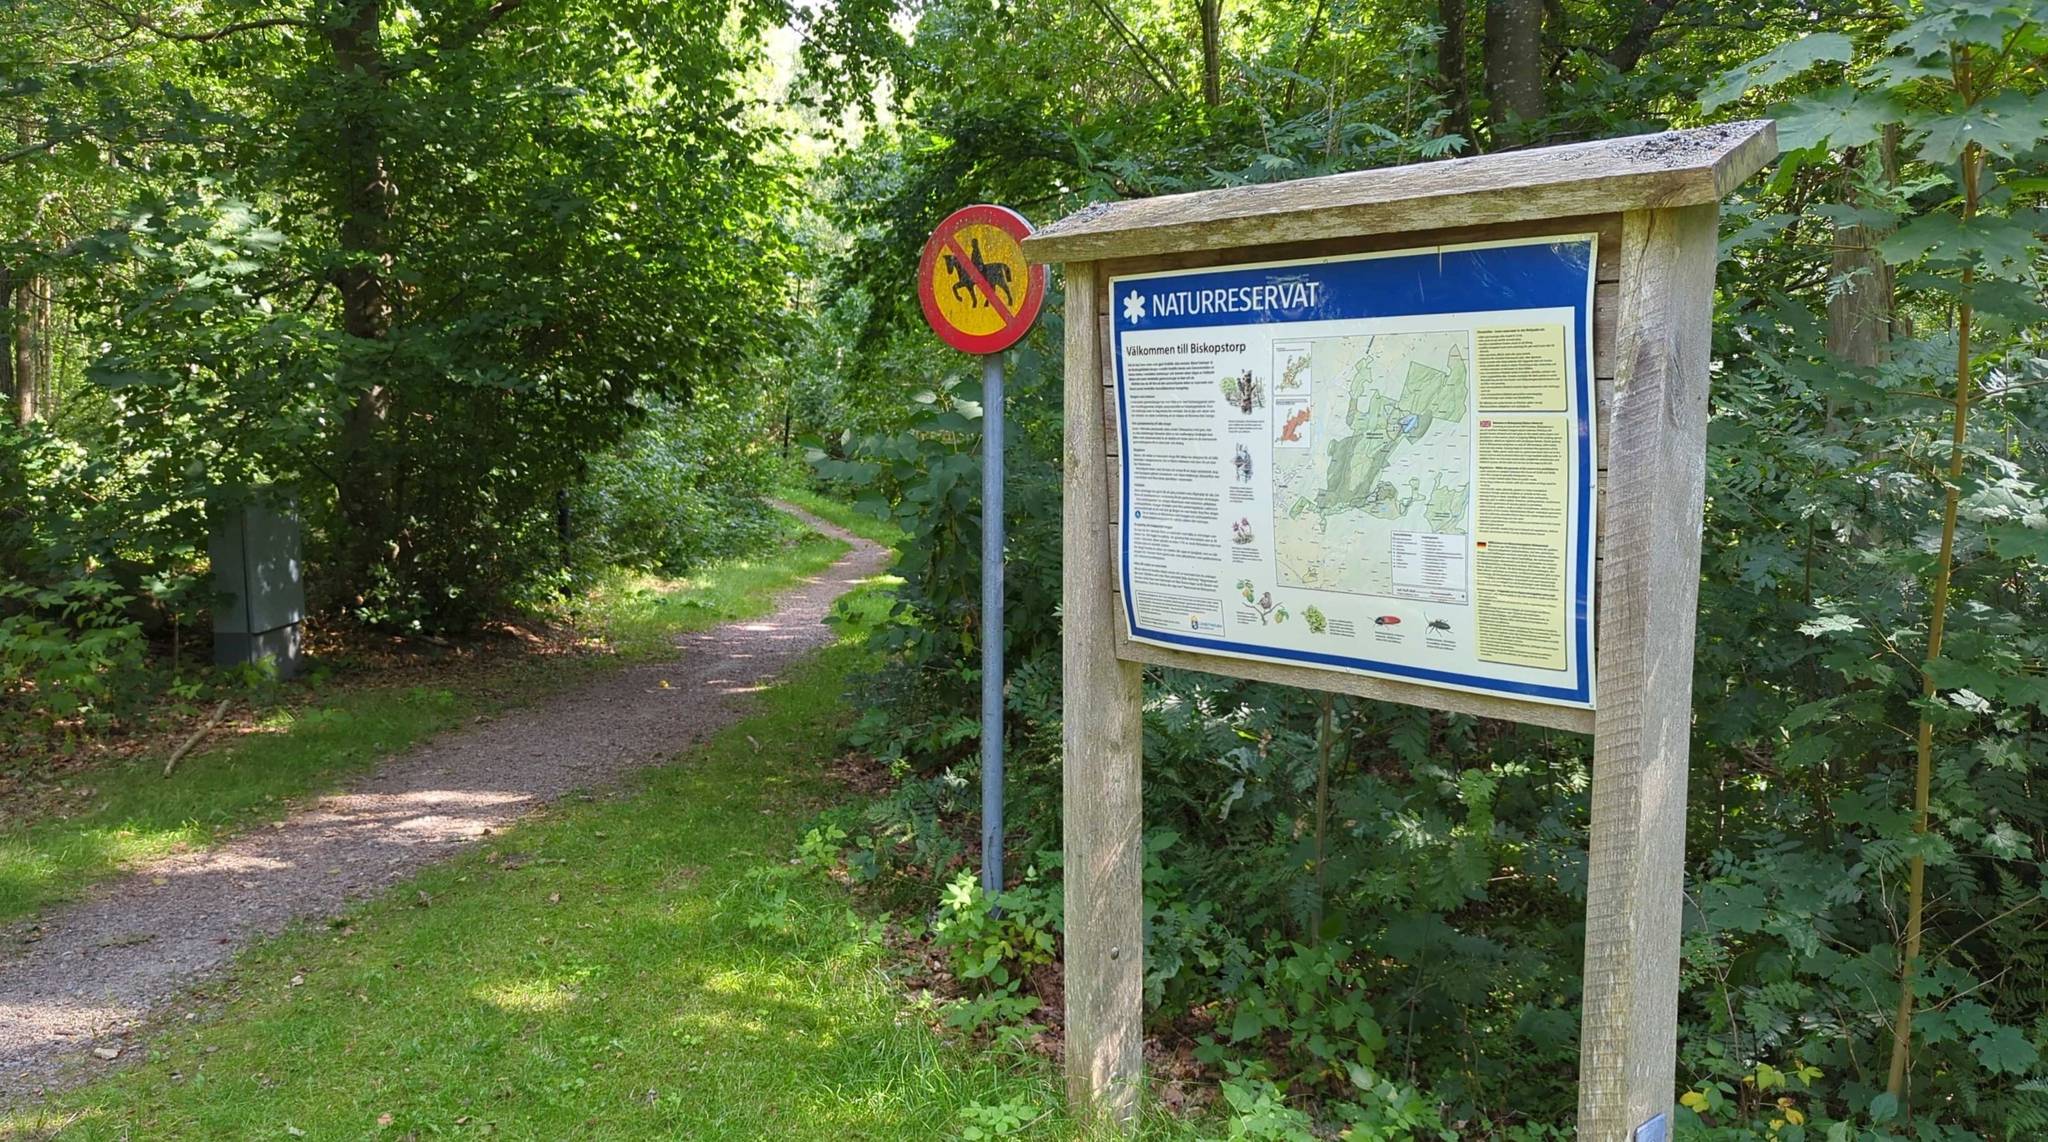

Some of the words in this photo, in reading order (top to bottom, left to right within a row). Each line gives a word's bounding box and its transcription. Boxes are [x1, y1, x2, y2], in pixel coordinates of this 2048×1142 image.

[1153, 282, 1319, 317] NATURRESERVAT
[1126, 345, 1175, 356] Välkommen
[1177, 343, 1188, 354] till
[1190, 342, 1246, 355] Biskopstorp
